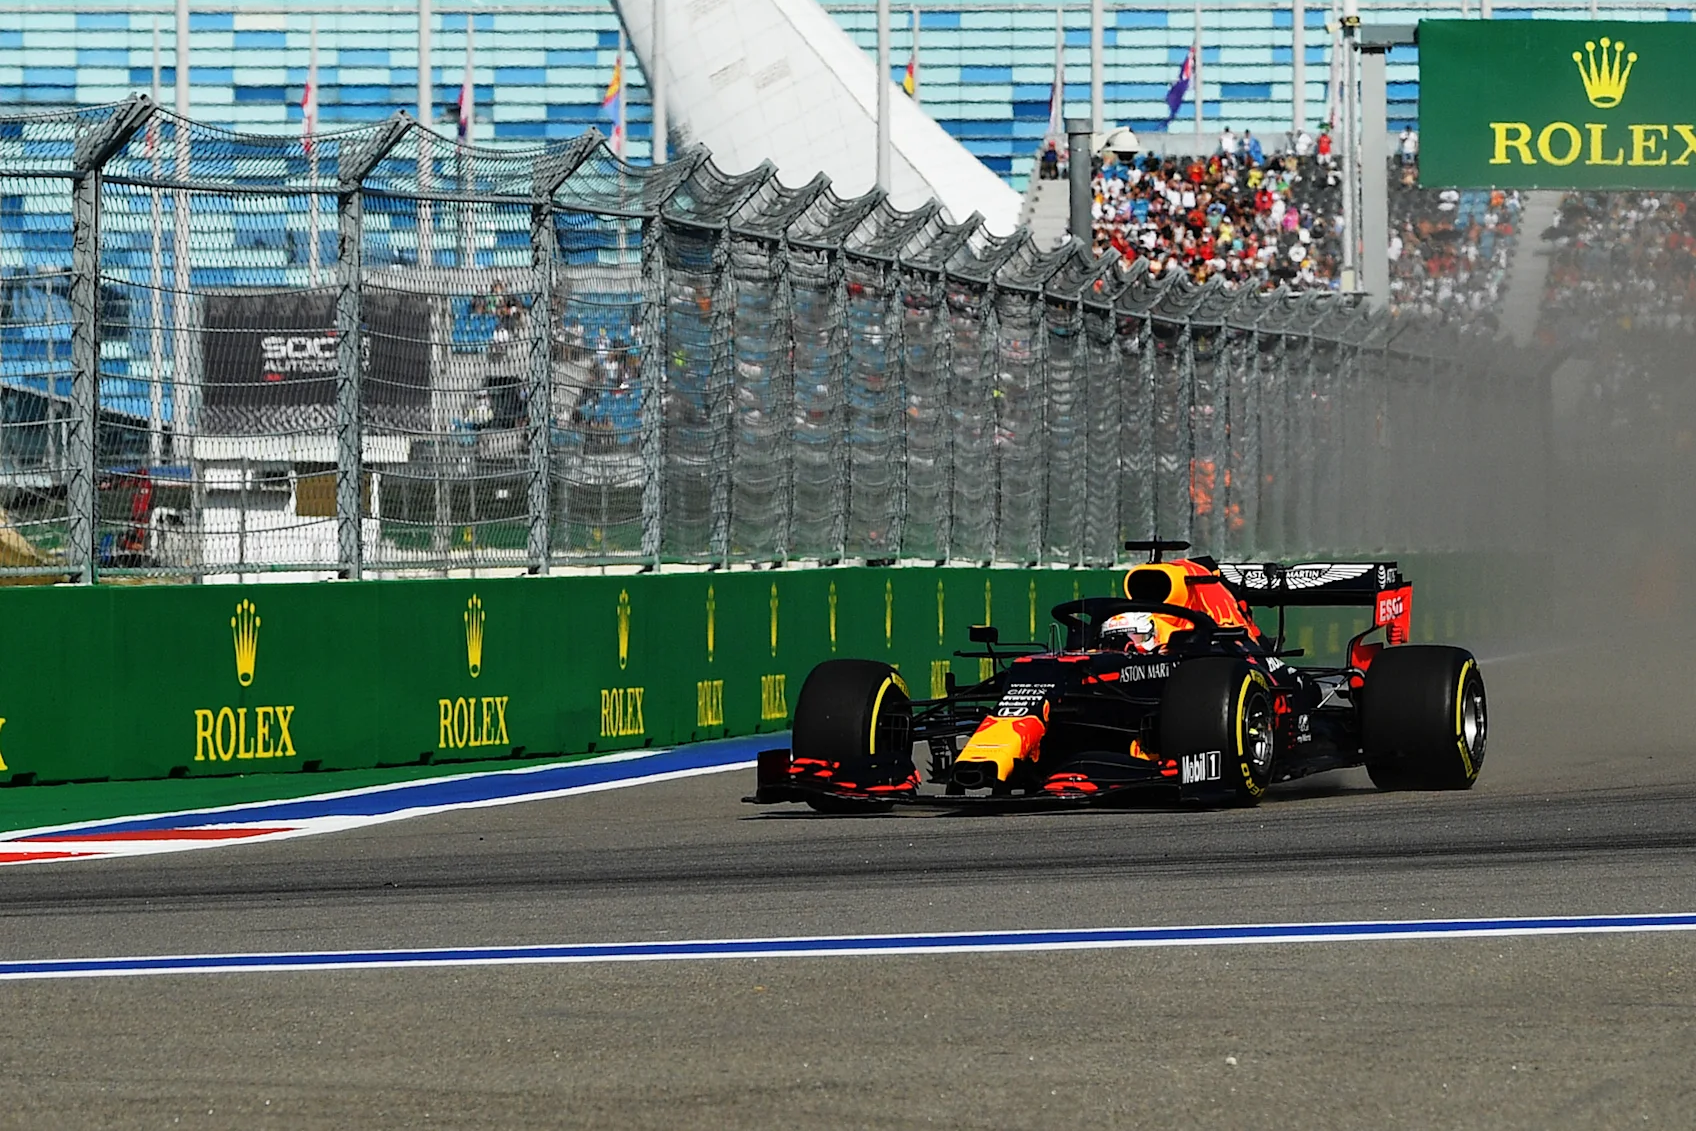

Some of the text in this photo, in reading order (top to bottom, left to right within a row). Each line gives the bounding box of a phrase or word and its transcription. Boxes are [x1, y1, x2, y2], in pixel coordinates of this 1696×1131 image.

[1286, 571, 1320, 579] MARTIN
[1120, 662, 1172, 683] ASTON MART
[439, 696, 509, 748] ROLEX
[601, 687, 644, 736] ROLEX
[195, 705, 296, 761] ROLEX
[1182, 752, 1206, 784] Mobil
